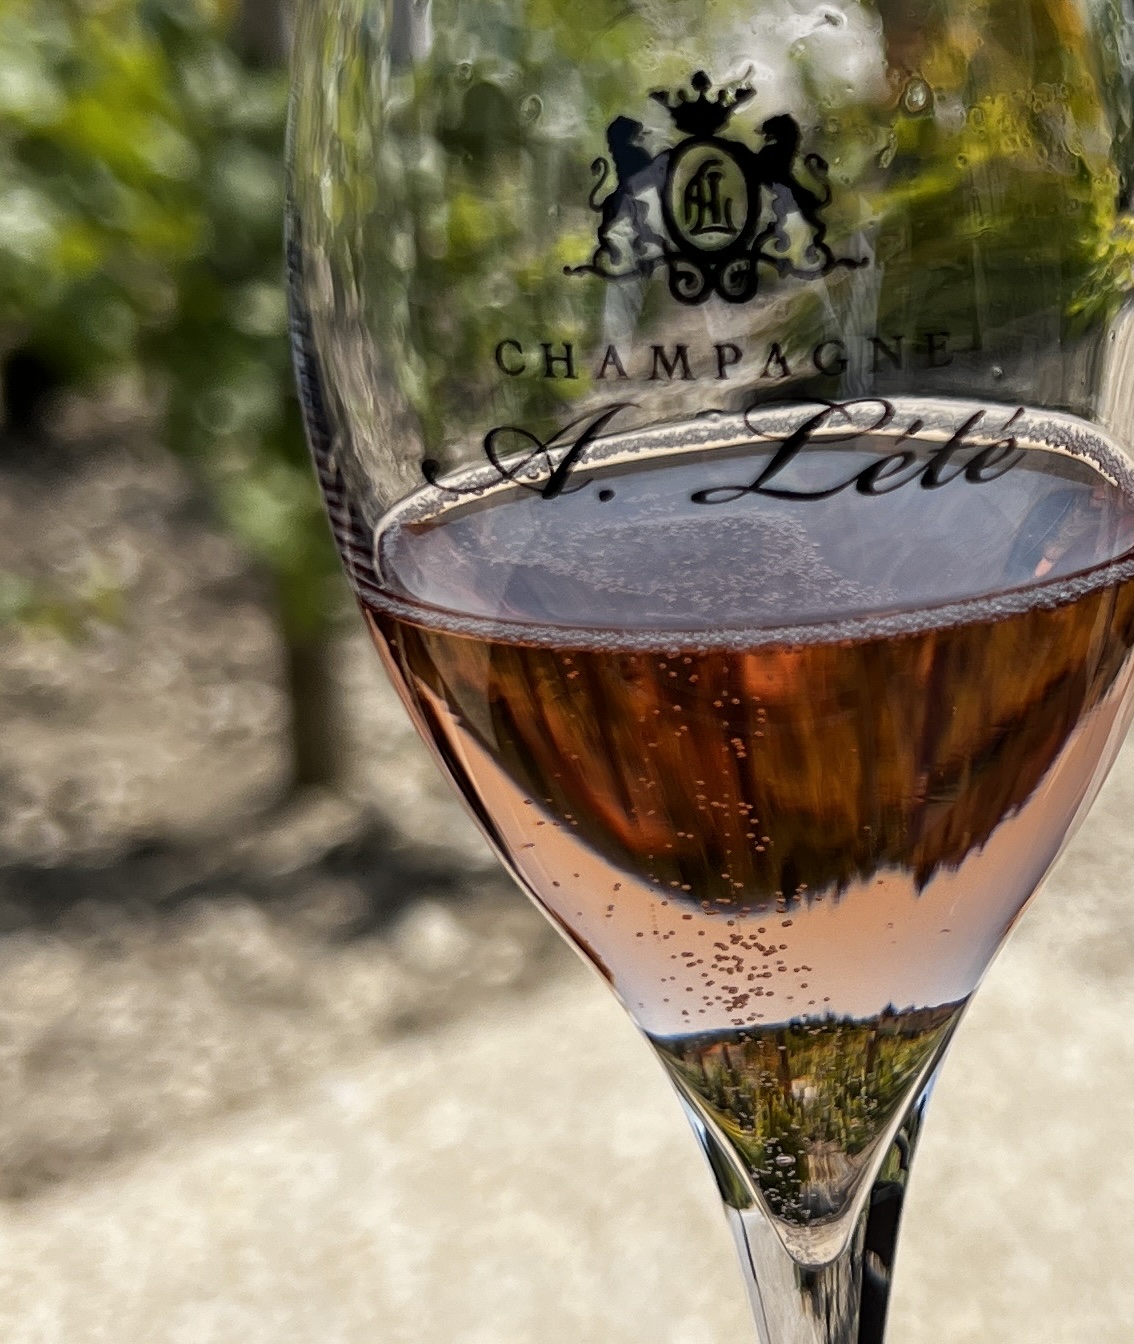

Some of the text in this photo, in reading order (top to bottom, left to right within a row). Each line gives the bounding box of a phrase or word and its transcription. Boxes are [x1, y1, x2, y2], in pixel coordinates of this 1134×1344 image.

[494, 330, 955, 382] CHAMPAGNE
[420, 396, 1033, 505] A. Lété
